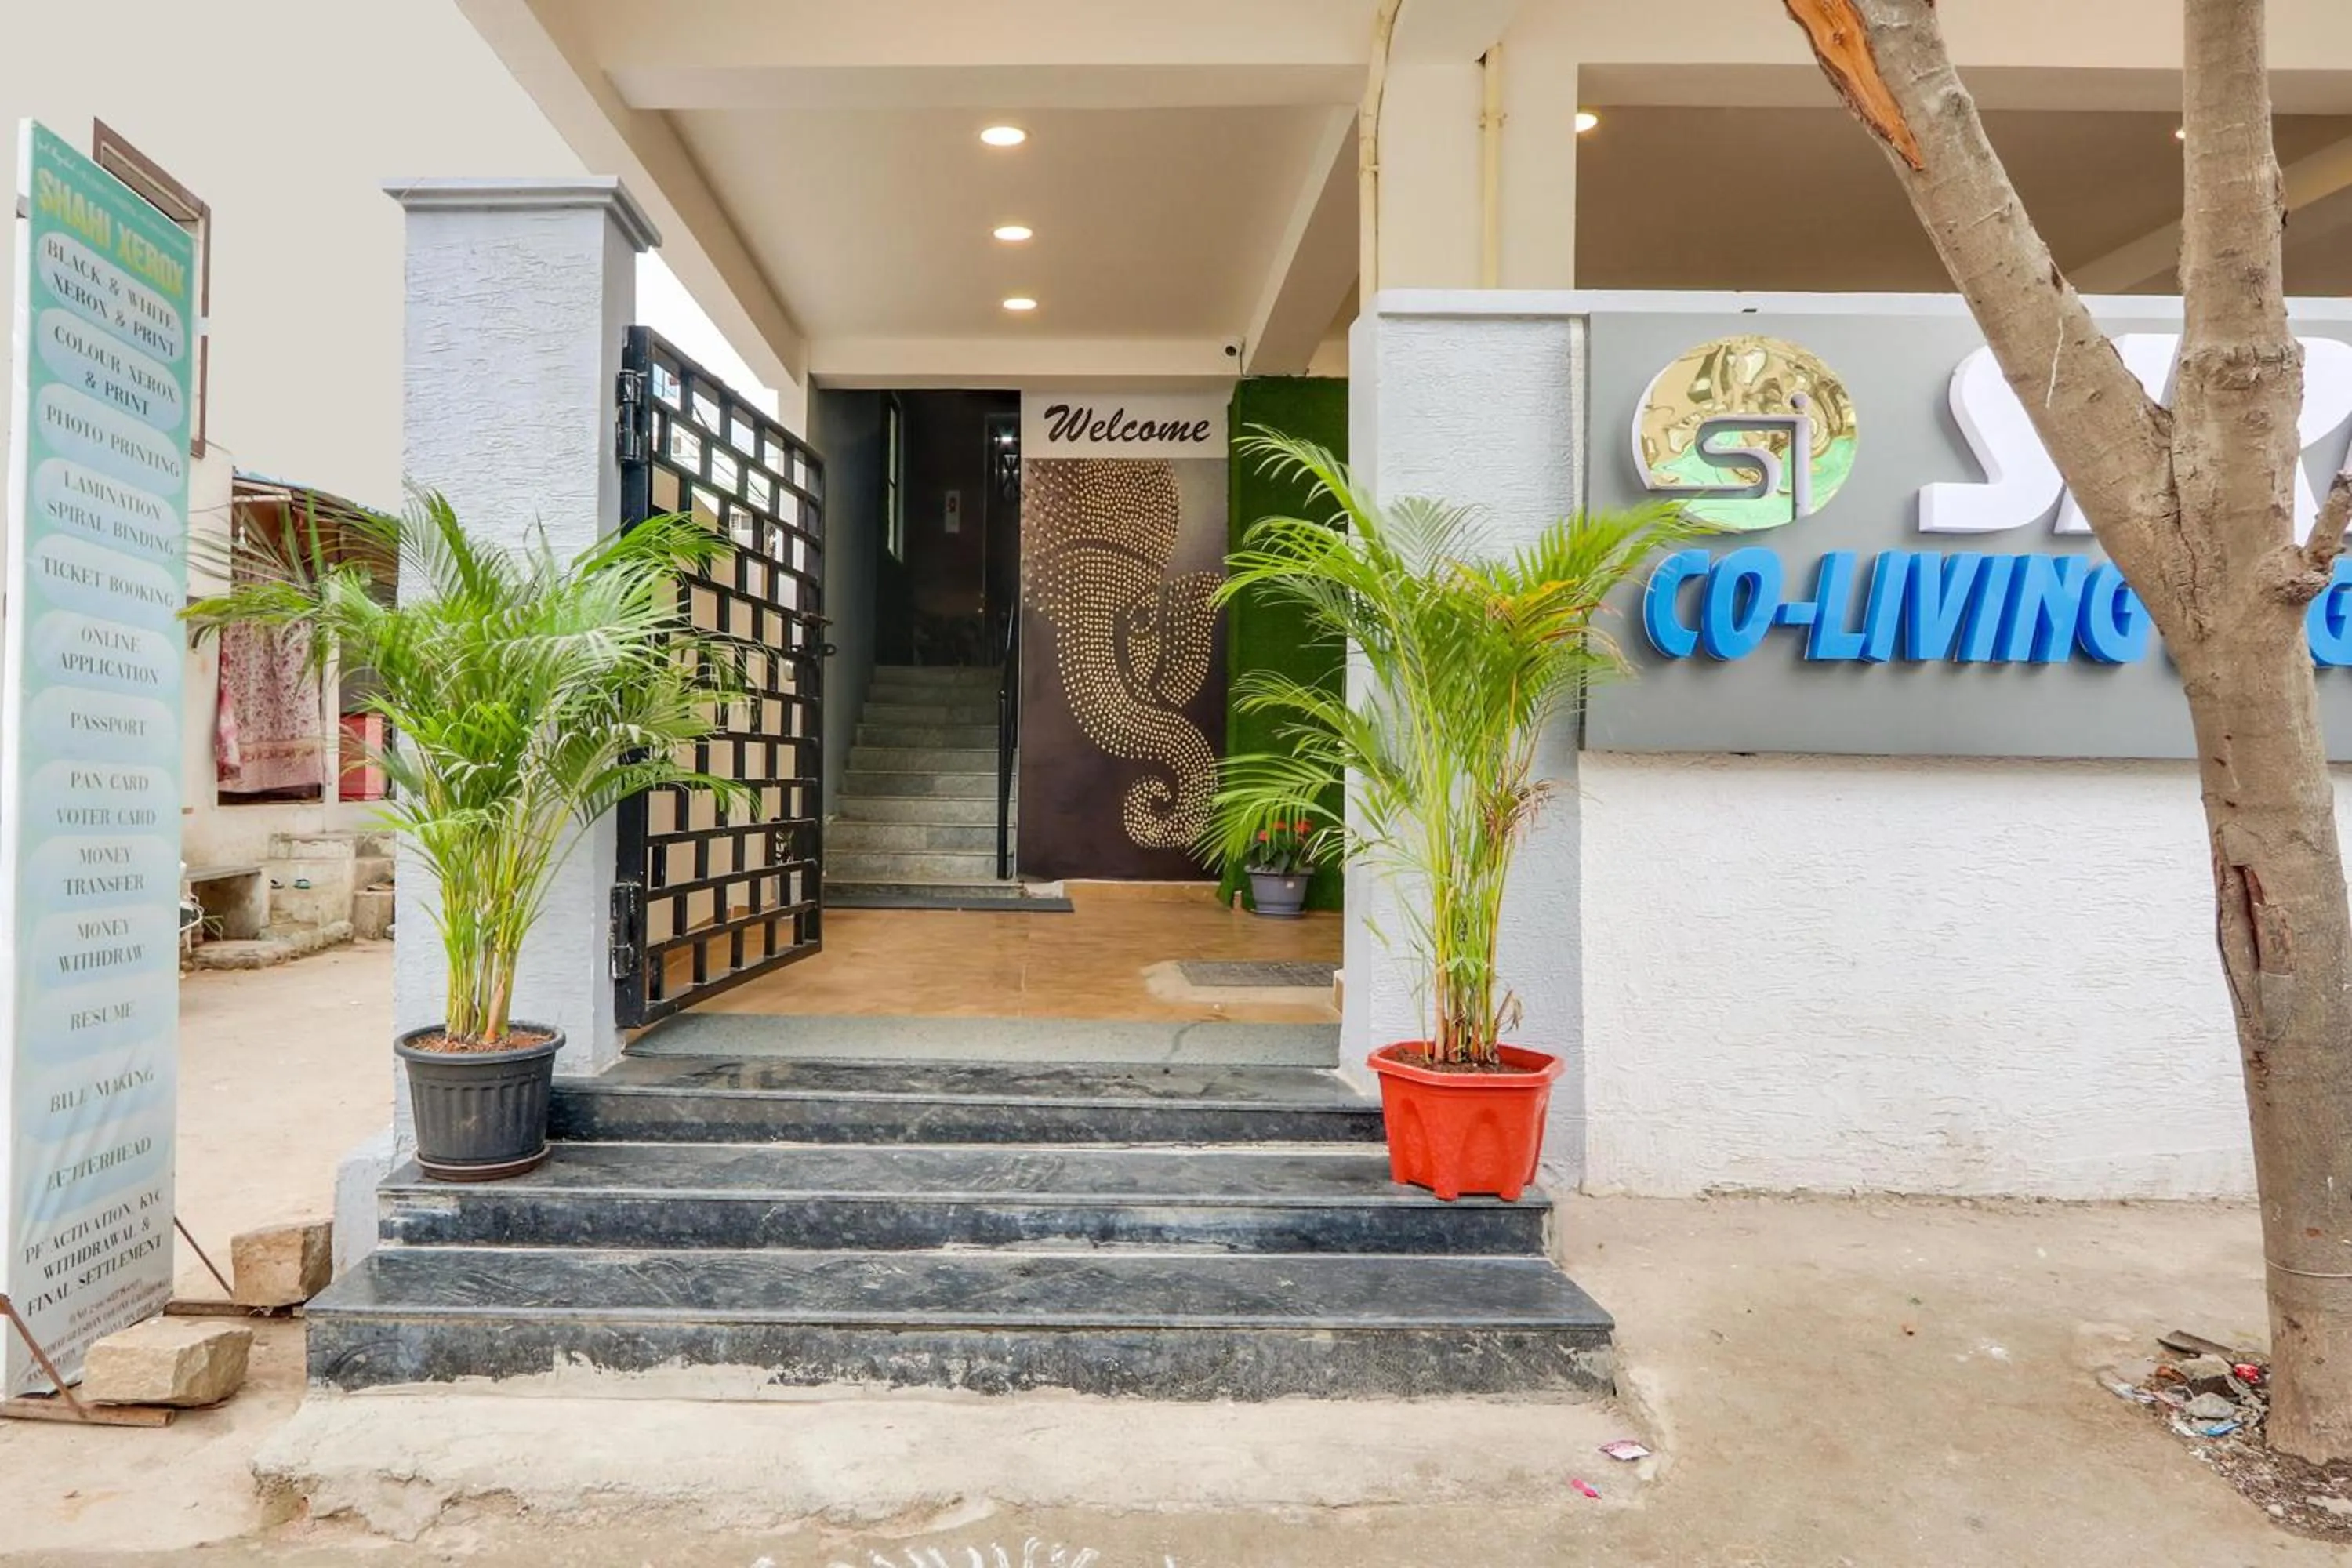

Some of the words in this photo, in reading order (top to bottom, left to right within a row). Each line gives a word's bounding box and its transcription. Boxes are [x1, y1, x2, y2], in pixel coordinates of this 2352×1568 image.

[38, 167, 111, 251] SHAHI
[47, 238, 101, 288] BLACK
[108, 276, 118, 295] &
[129, 289, 174, 331] WHITE
[53, 274, 107, 318] XEROX
[115, 313, 125, 327] &
[133, 321, 175, 358] PRINT
[54, 325, 120, 373] COLOUR
[129, 365, 175, 403] XEROX
[85, 371, 96, 389] &
[105, 379, 149, 416] PRINT
[46, 405, 103, 443] PHOTO
[111, 434, 180, 477] PRINTING
[1044, 404, 1211, 443] Welcome
[64, 471, 162, 521] LAMINATION
[47, 501, 105, 532] SPIRAL
[114, 522, 174, 556] BINDING
[42, 556, 103, 587] TICKET
[110, 575, 174, 607] BOOKING
[1643, 546, 2153, 662] CO-LIVING
[81, 626, 140, 652] ONLINE
[60, 652, 159, 684] APPLICATION
[71, 711, 147, 736] PASSPORT
[71, 771, 103, 789] PAN
[110, 773, 149, 792] CARD
[56, 808, 110, 826] VOTER
[117, 808, 156, 826] CARD
[79, 847, 132, 863] MONEY
[64, 875, 144, 895] TRANSFER
[78, 920, 129, 939] MONEY
[58, 945, 145, 973] WITHDRAW
[70, 1001, 135, 1031] RESUME
[50, 1088, 89, 1114] BILL
[95, 1068, 154, 1097] MAKING
[46, 1137, 151, 1192] LETTERHEAD
[25, 1237, 45, 1266] PF
[50, 1203, 132, 1254] ACTIVATION
[140, 1188, 163, 1210] KYC
[43, 1229, 137, 1281] WITHDRAWAL
[142, 1218, 151, 1233] &
[27, 1280, 72, 1317] FINAL
[78, 1234, 163, 1291] SETTLEMENT
